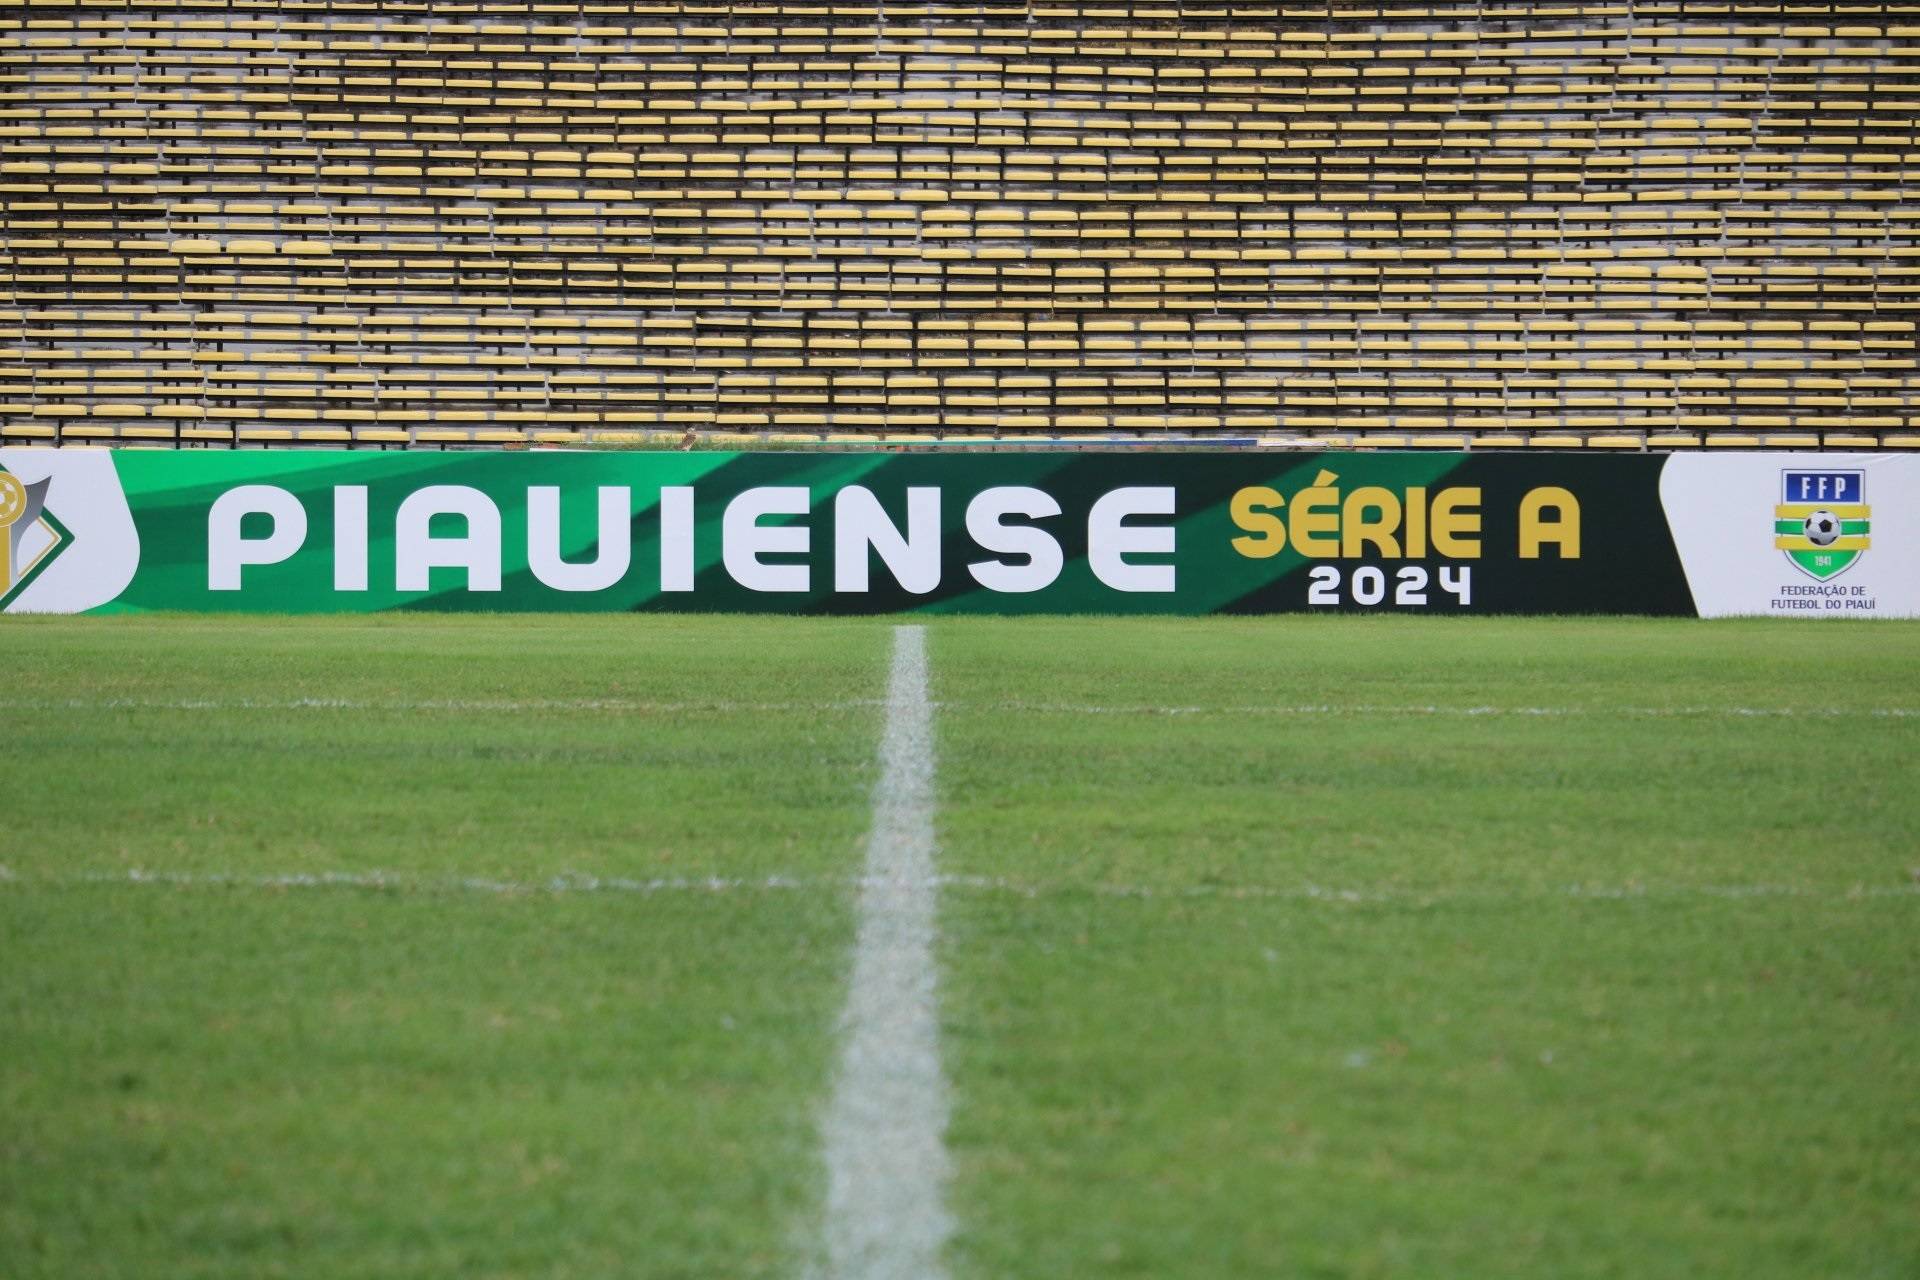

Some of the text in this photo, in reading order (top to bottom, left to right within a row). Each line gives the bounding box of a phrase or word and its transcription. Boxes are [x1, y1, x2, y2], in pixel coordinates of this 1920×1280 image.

[1801, 477, 1846, 499] FFP
[1230, 469, 1580, 558] SÉRIE A
[208, 485, 1175, 594] PIAUIENSE
[1814, 555, 1832, 567] 1941
[1308, 566, 1471, 605] 2024
[1781, 585, 1866, 598] FEDERAÇÃO DE
[1771, 598, 1876, 610] FUTEBOL DO PIAUÍ
